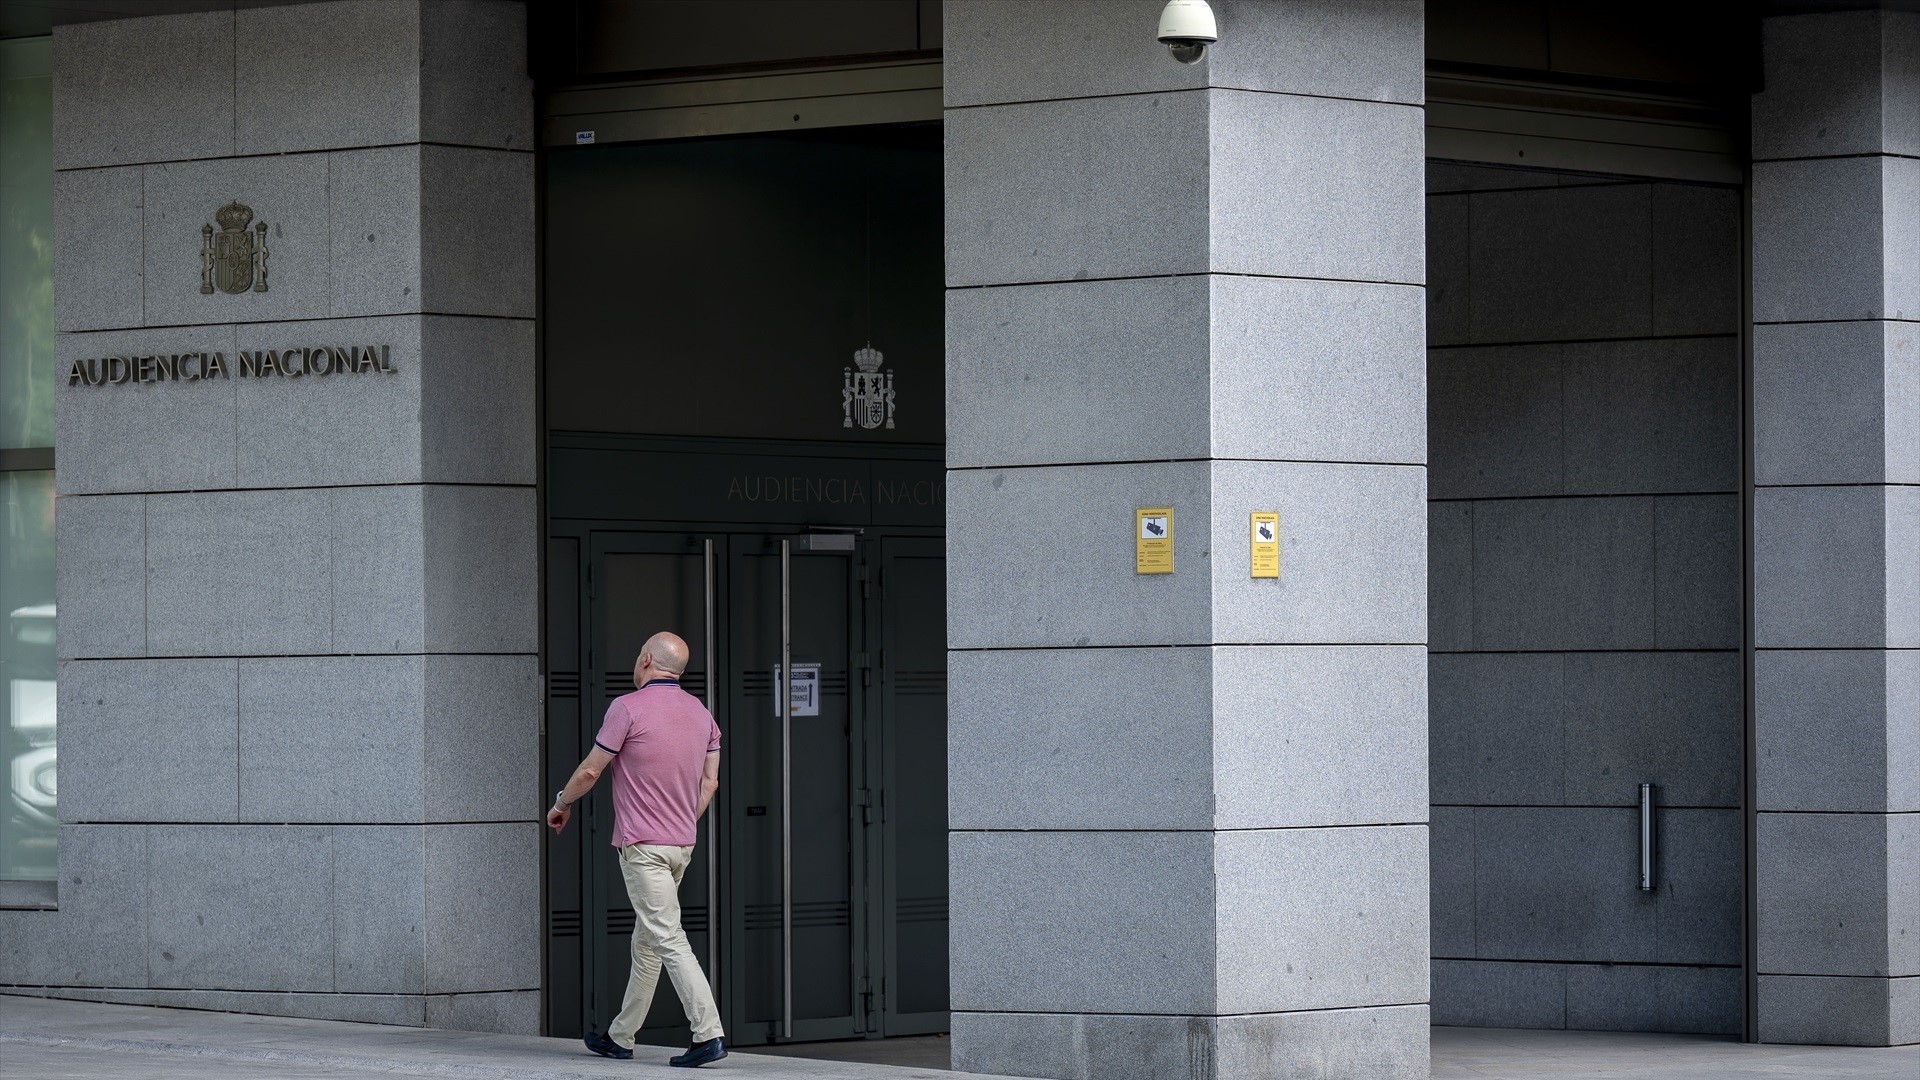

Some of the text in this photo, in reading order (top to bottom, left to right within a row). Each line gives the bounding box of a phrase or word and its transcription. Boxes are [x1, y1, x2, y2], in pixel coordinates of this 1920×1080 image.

[68, 345, 396, 386] AUDIENCIA NACIONAL
[727, 475, 865, 504] AUDIENCIA
